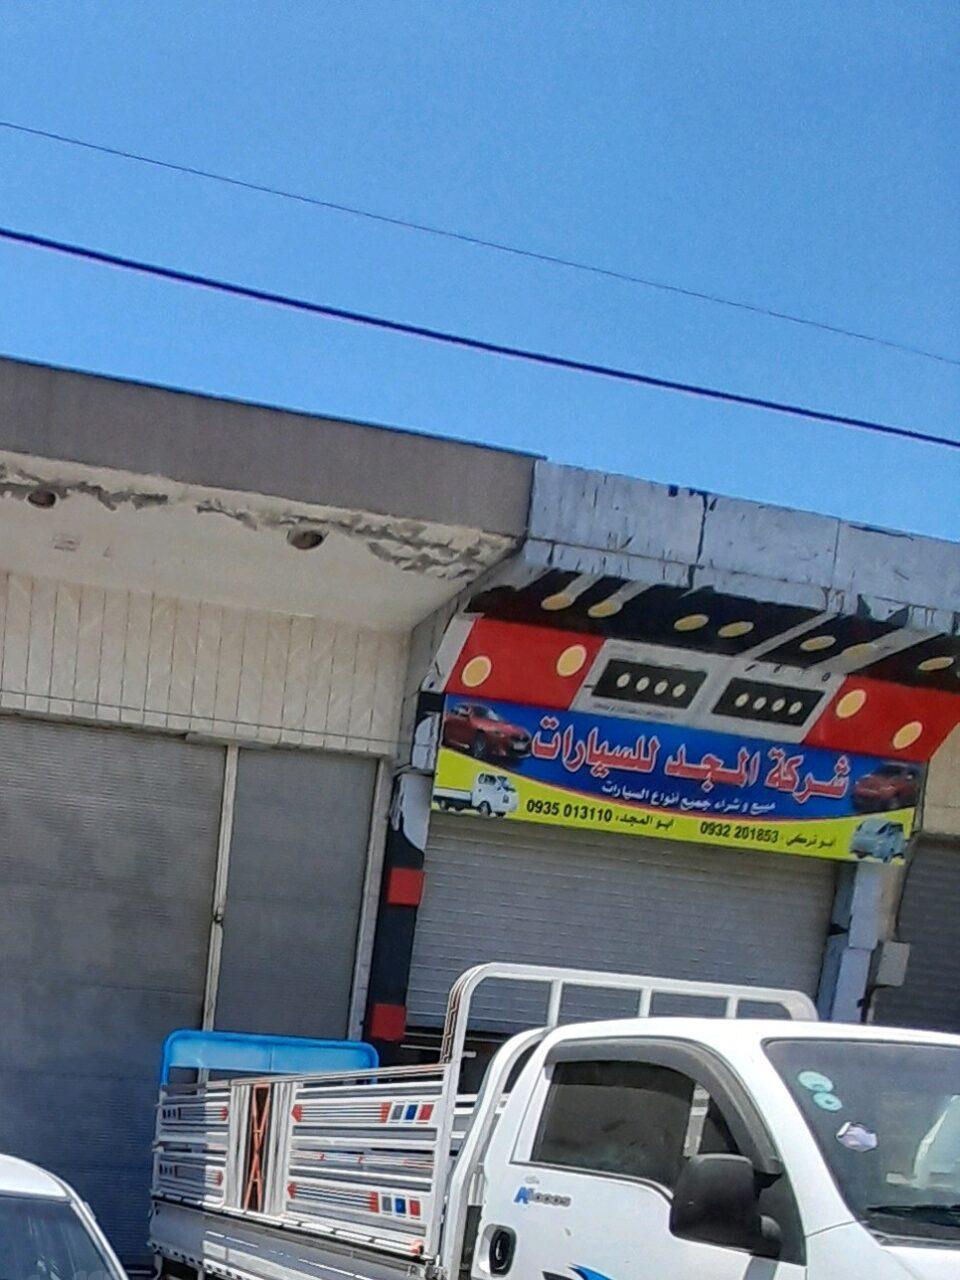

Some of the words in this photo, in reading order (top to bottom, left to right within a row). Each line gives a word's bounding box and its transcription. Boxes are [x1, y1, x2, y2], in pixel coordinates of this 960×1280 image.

[531, 714, 661, 779] للسيارات
[664, 744, 761, 793] المجد
[764, 746, 850, 804] شركة
[602, 780, 650, 800] السيارات
[526, 799, 559, 816] 0935
[563, 804, 613, 822] 013110
[680, 797, 711, 811] جميع
[700, 821, 730, 838] 0932
[734, 825, 780, 843] 201853
